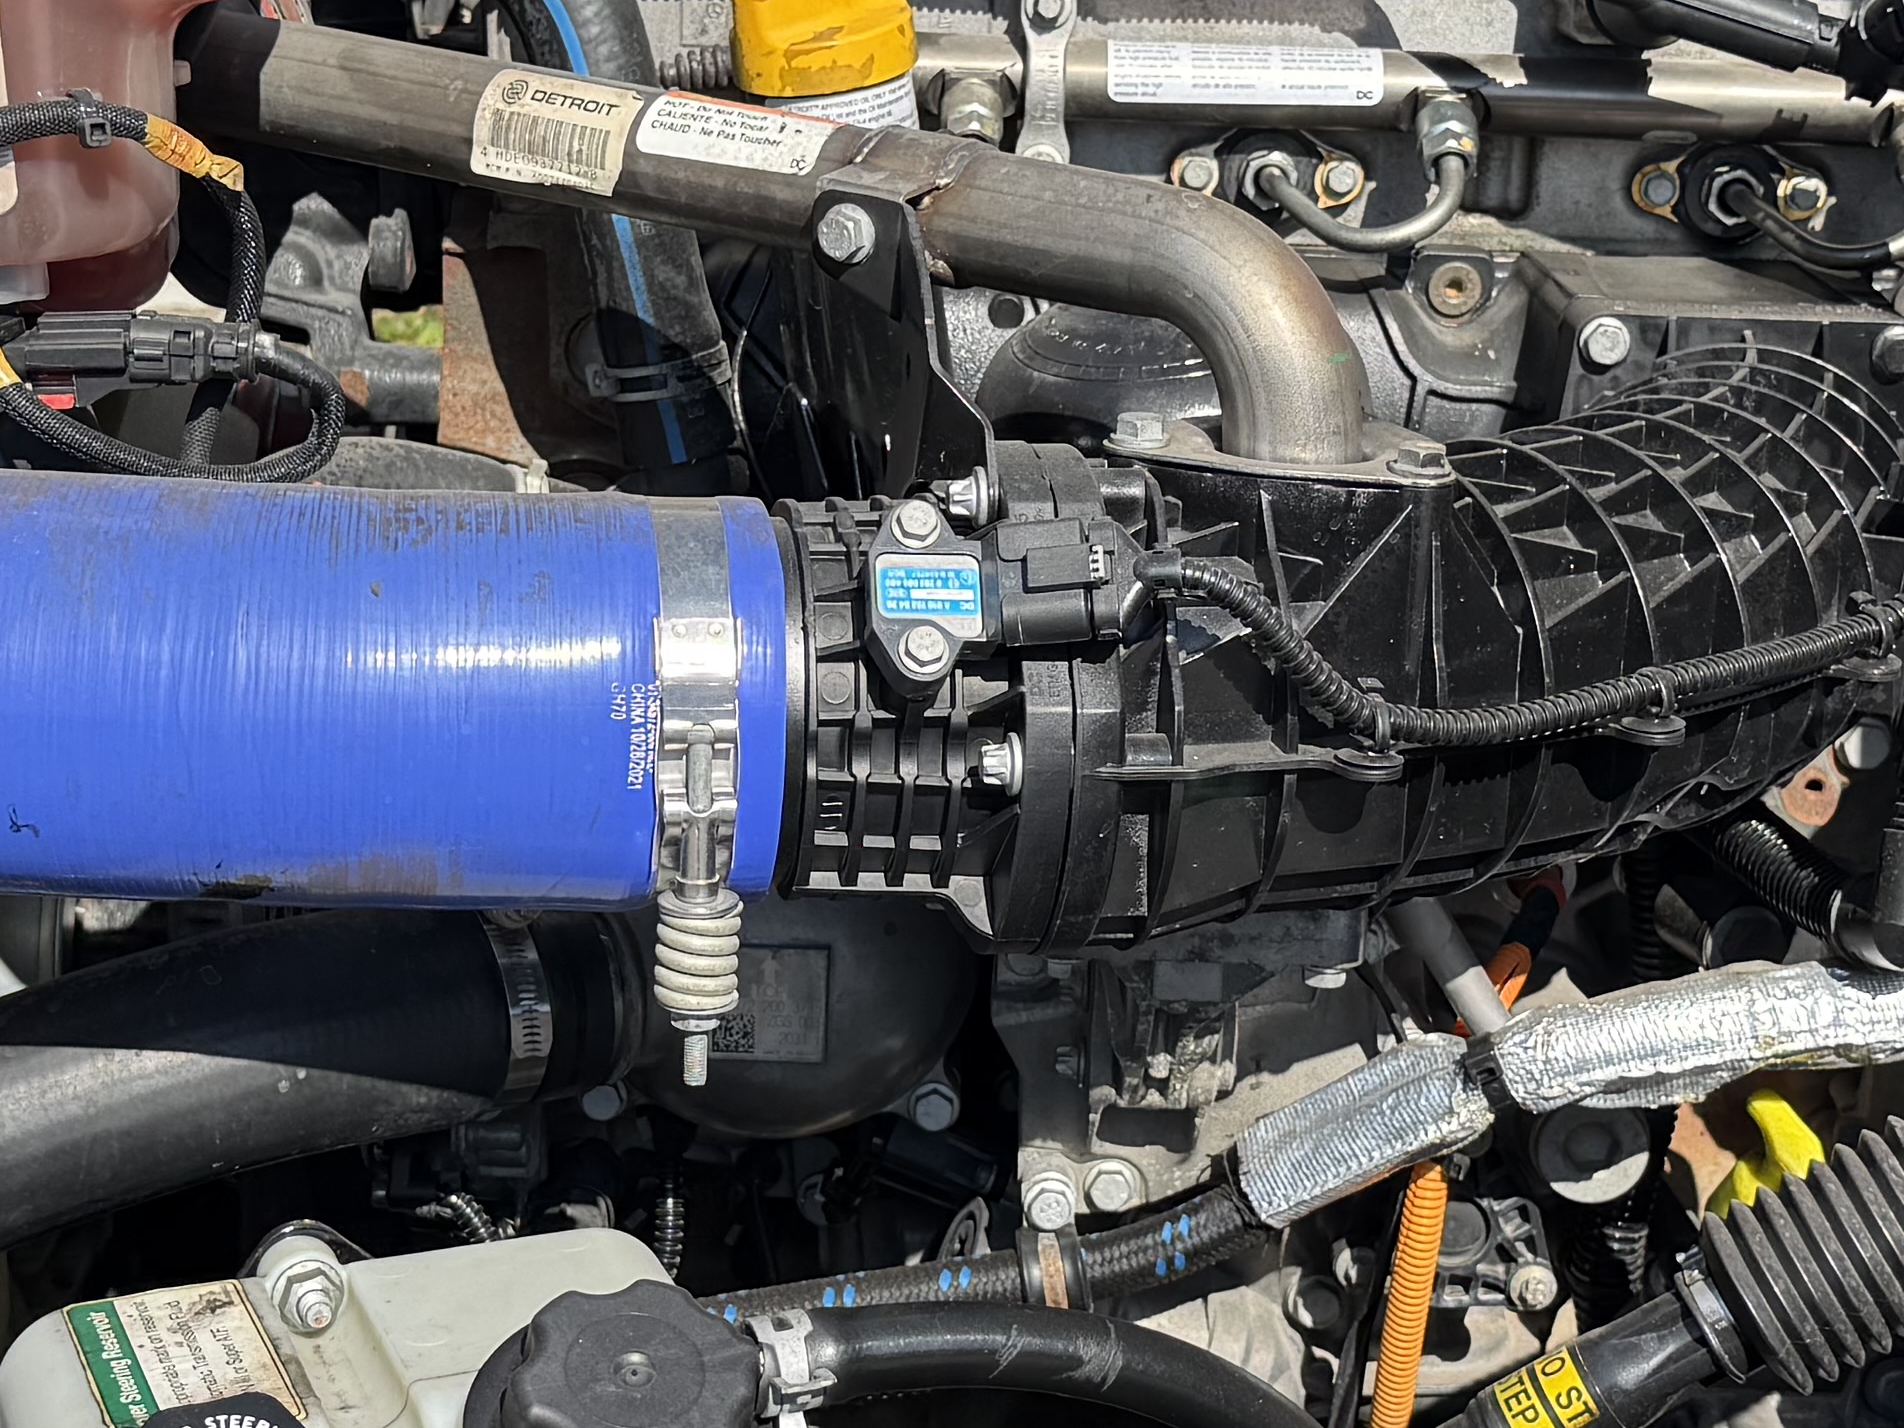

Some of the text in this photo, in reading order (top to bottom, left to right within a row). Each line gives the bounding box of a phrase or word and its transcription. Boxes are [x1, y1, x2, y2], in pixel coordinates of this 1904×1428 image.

[530, 89, 622, 117] DETROIT
[651, 120, 691, 135] CHAUD
[656, 108, 713, 124] CALIENTE
[626, 682, 647, 791] CHINA 10/28/2021
[82, 1308, 125, 1360] Reservoir
[102, 1355, 147, 1404] Steering
[1498, 1373, 1540, 1424] TEP
